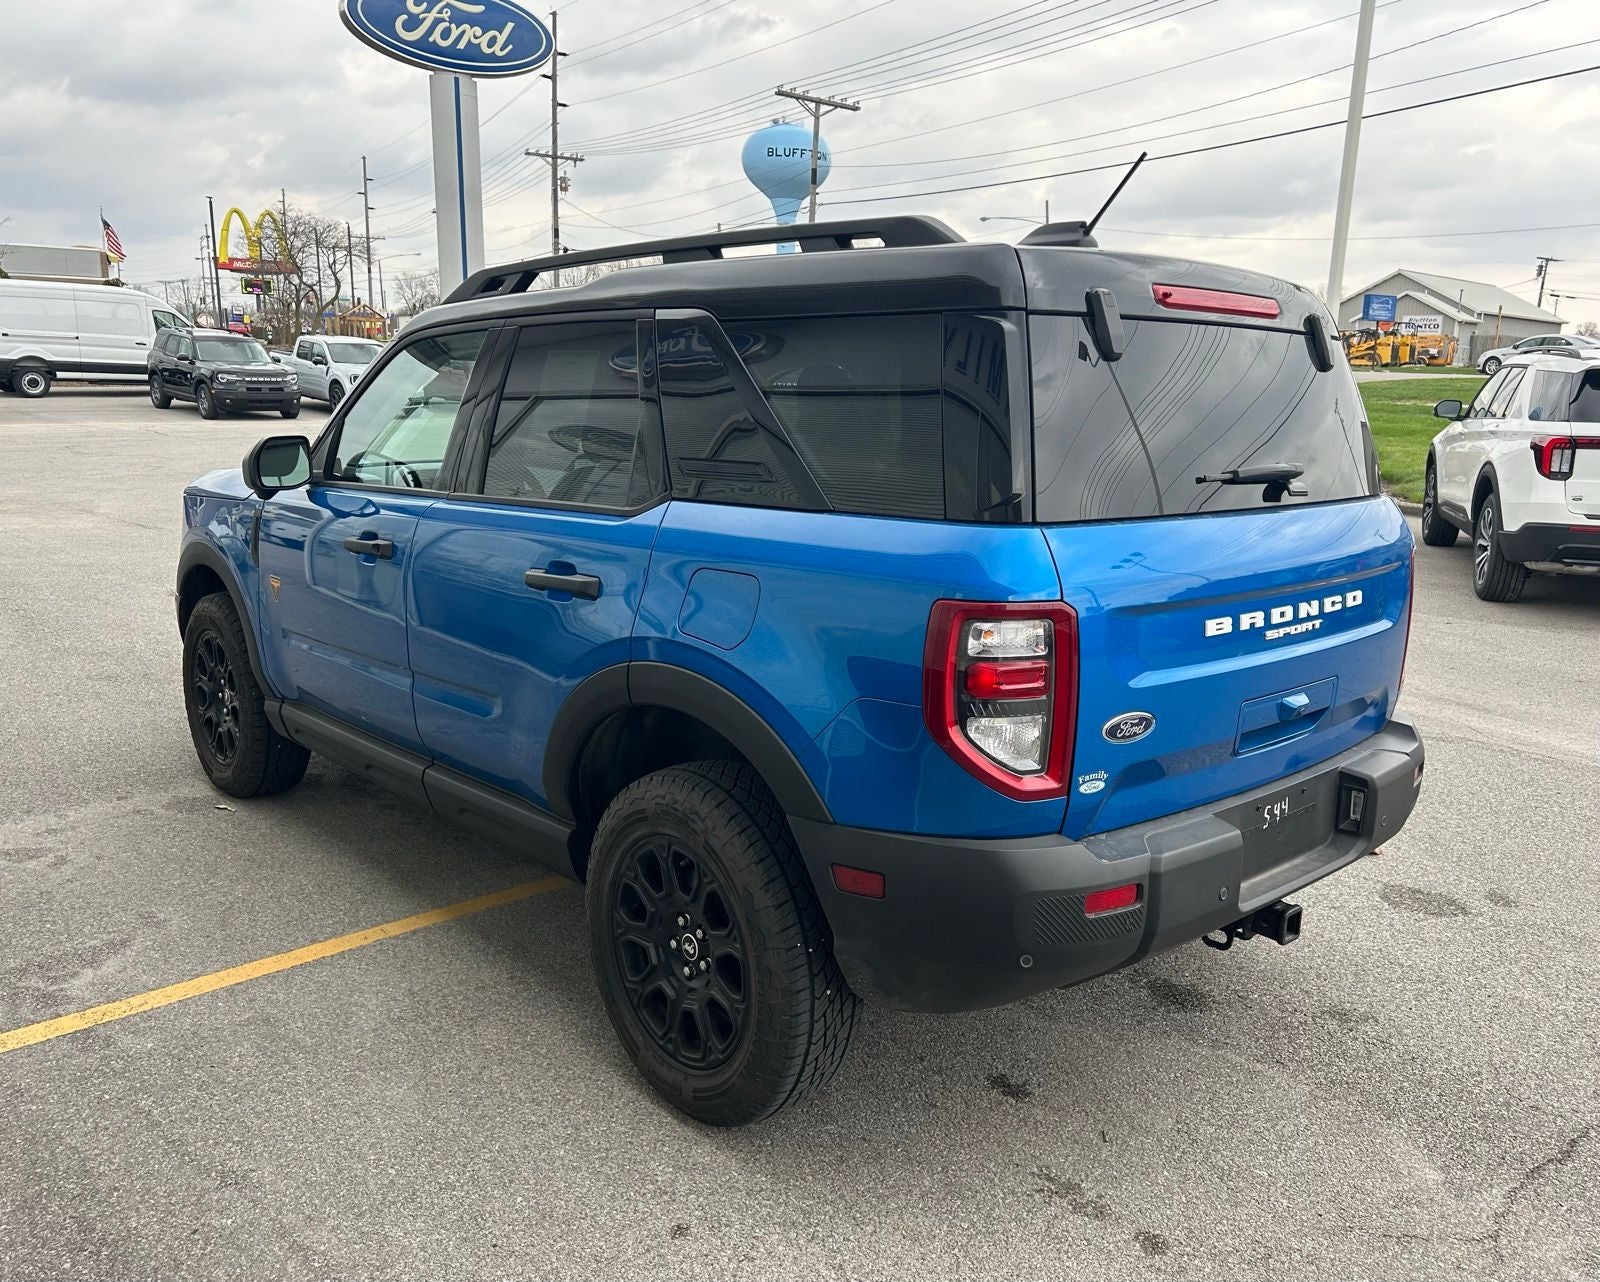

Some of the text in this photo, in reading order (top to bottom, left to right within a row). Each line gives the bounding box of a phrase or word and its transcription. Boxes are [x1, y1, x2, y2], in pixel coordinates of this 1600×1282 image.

[395, 0, 515, 57] Ford
[767, 147, 827, 161] BLUFFTON
[1204, 589, 1363, 637] BRONCO
[1264, 618, 1324, 640] SPORT
[1116, 718, 1147, 738] Ford
[1078, 770, 1109, 785] Family
